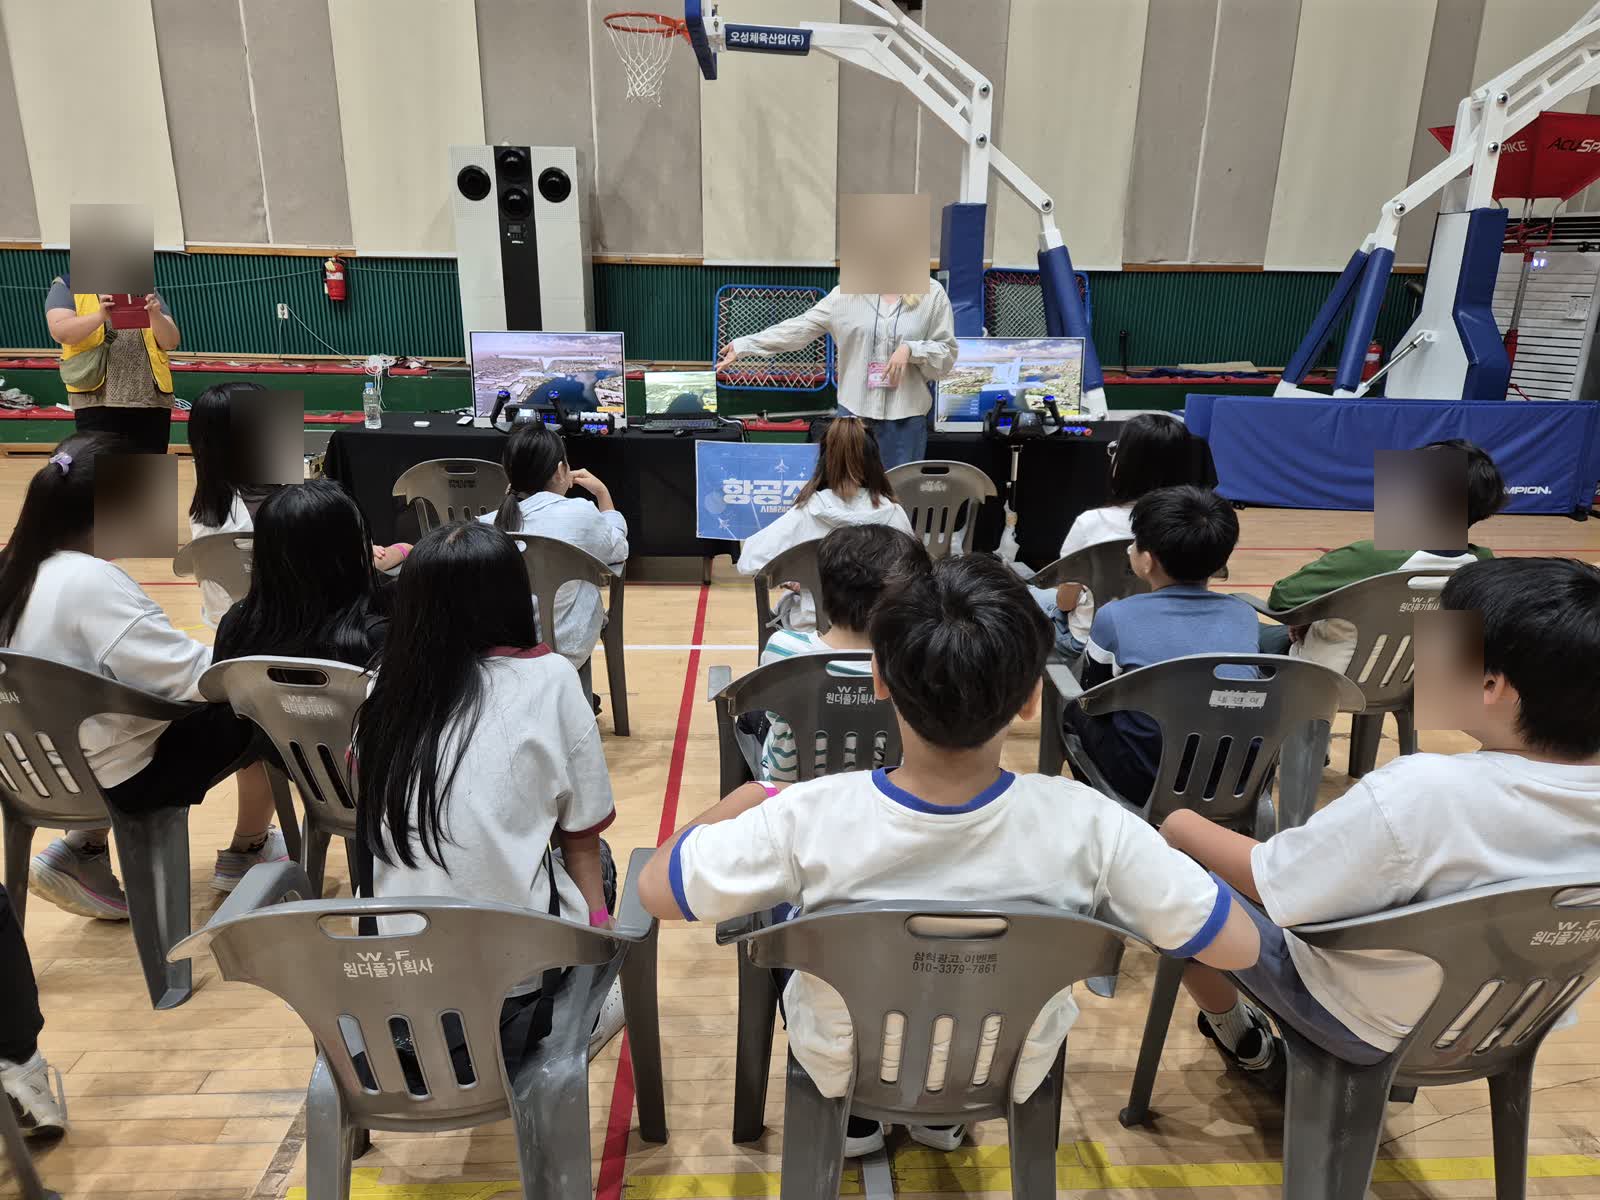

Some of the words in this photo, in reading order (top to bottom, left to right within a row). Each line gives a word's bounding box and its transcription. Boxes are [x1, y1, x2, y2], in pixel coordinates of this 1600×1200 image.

[730, 31, 804, 46] 오성체육산업(주)
[1500, 140, 1527, 153] PIKE
[356, 950, 410, 961] W.F
[912, 961, 997, 974] 010-3379-7861
